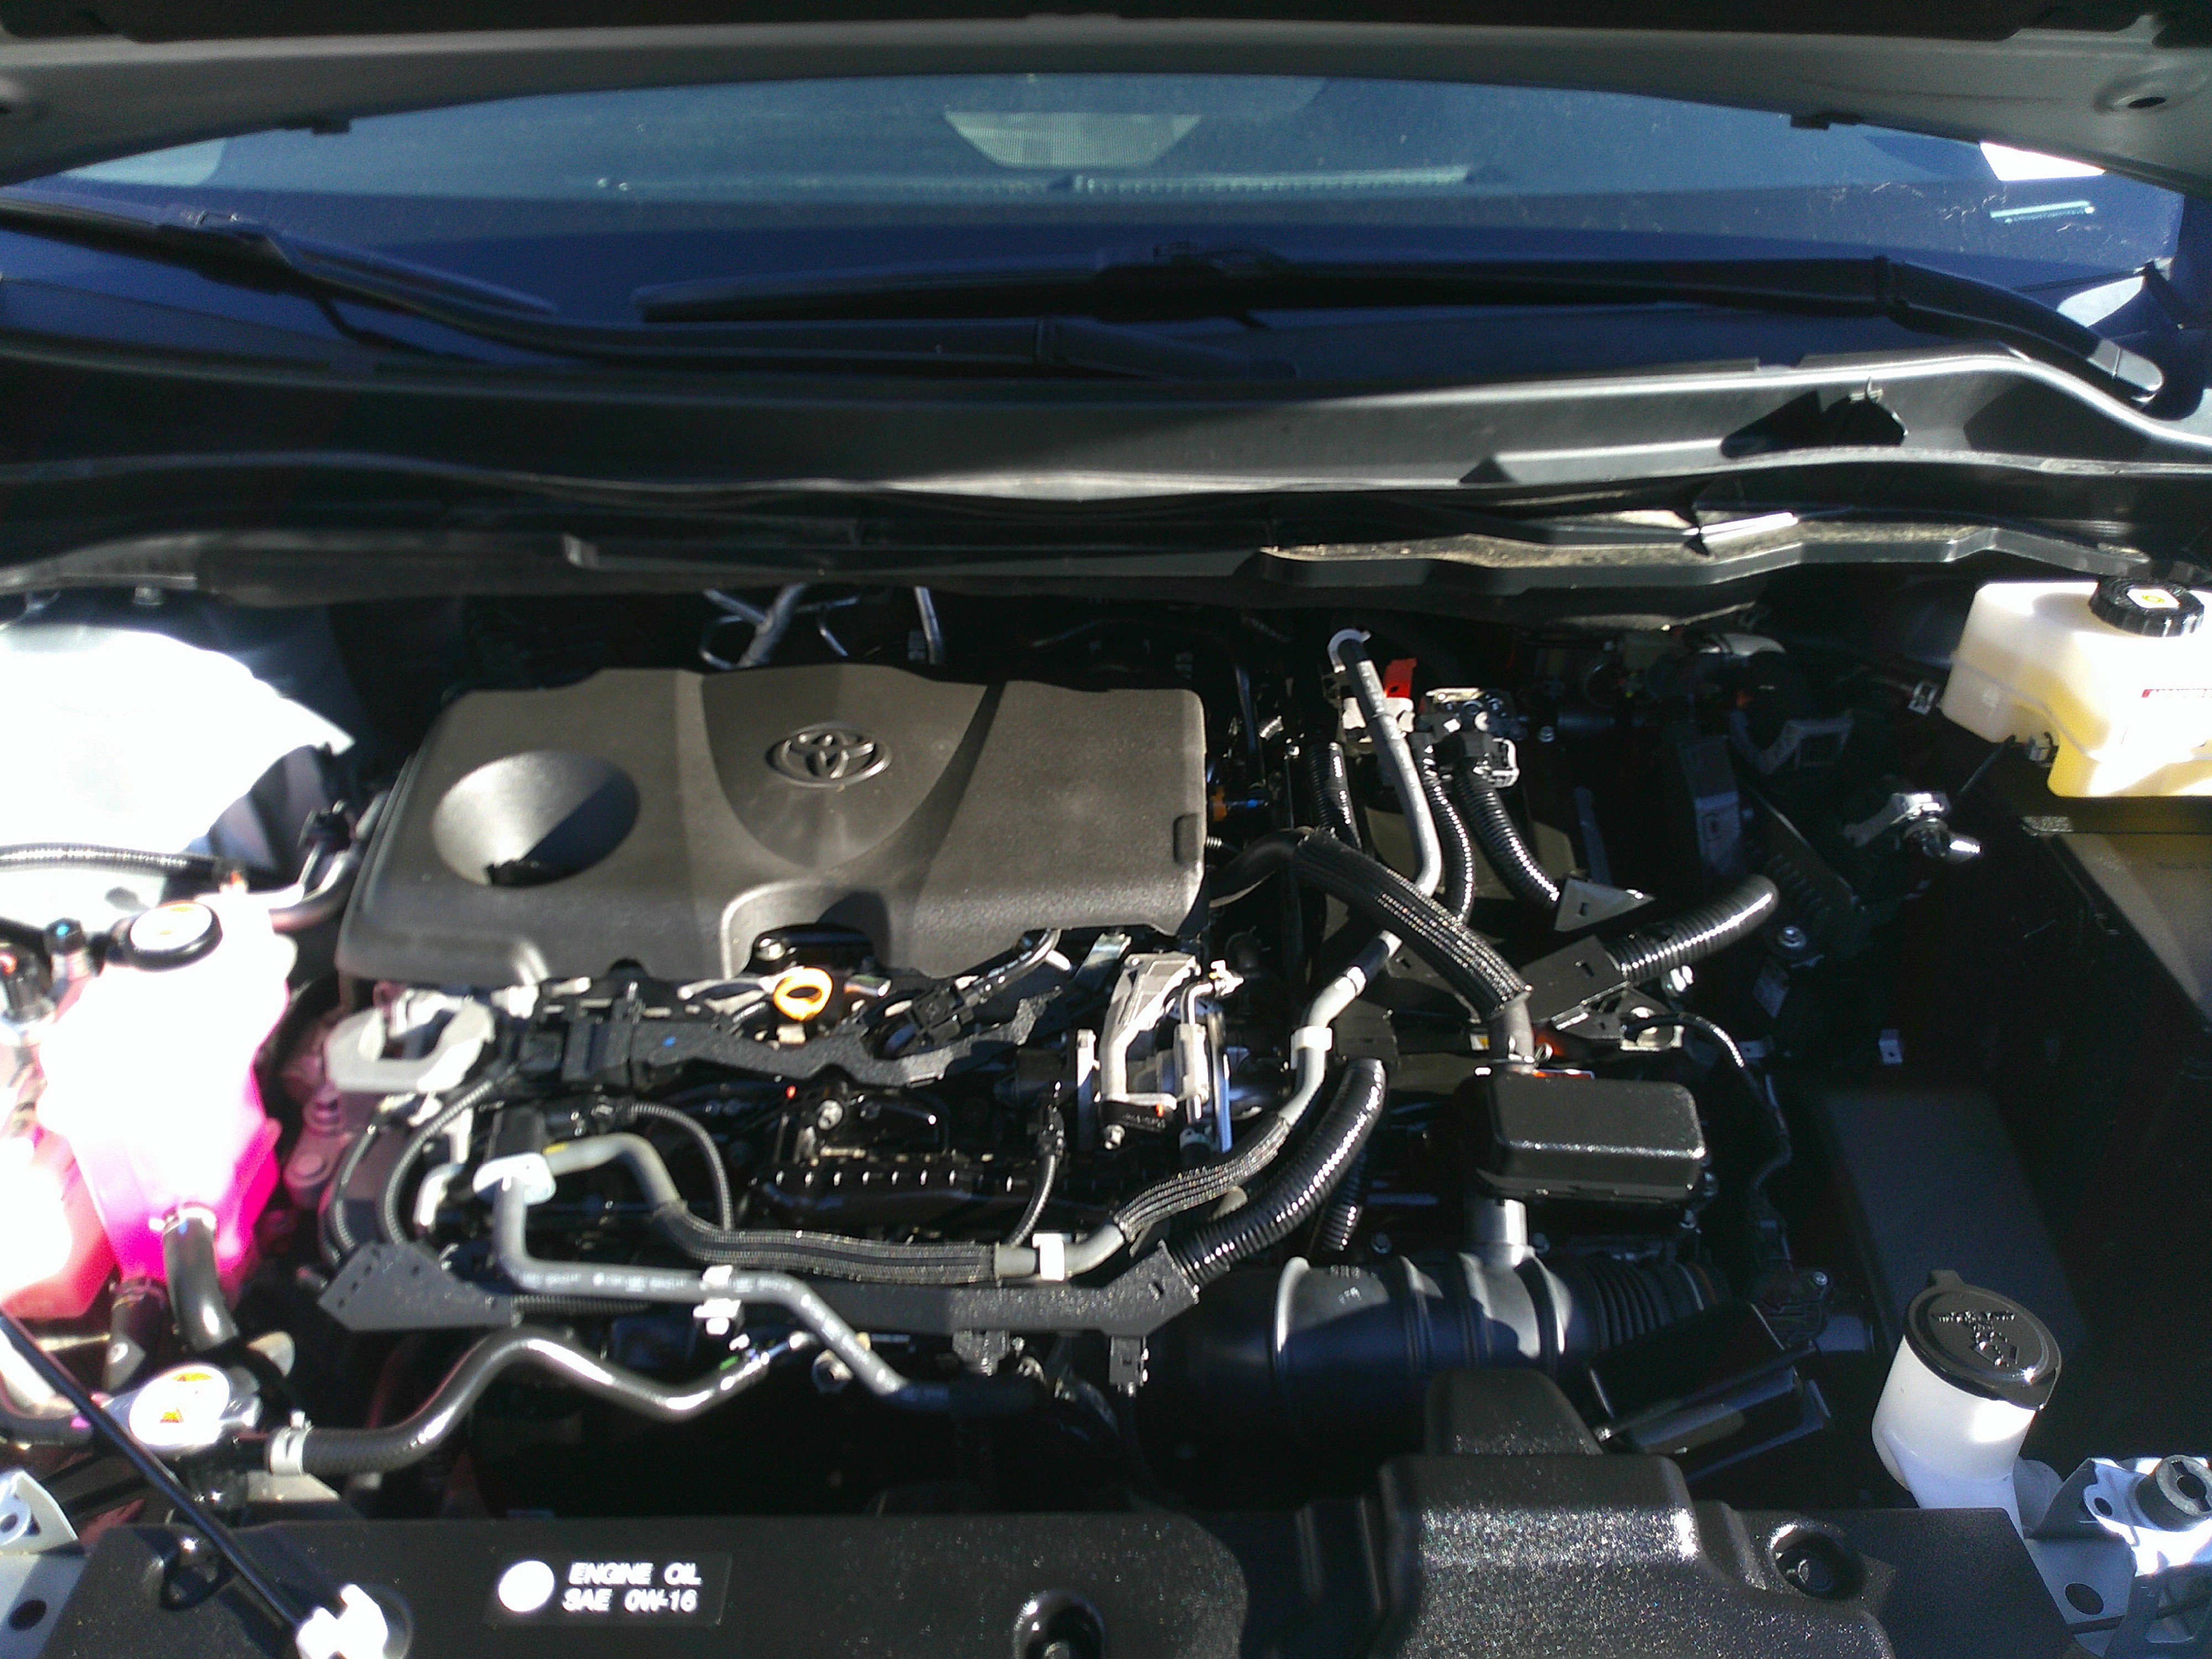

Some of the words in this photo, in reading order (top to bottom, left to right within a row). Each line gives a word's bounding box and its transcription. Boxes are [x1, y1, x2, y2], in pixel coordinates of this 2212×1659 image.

[568, 1562, 653, 1585] ENGINE
[664, 1562, 702, 1585] OIL
[562, 1588, 612, 1612] SAE
[624, 1588, 698, 1612] 0W-16
